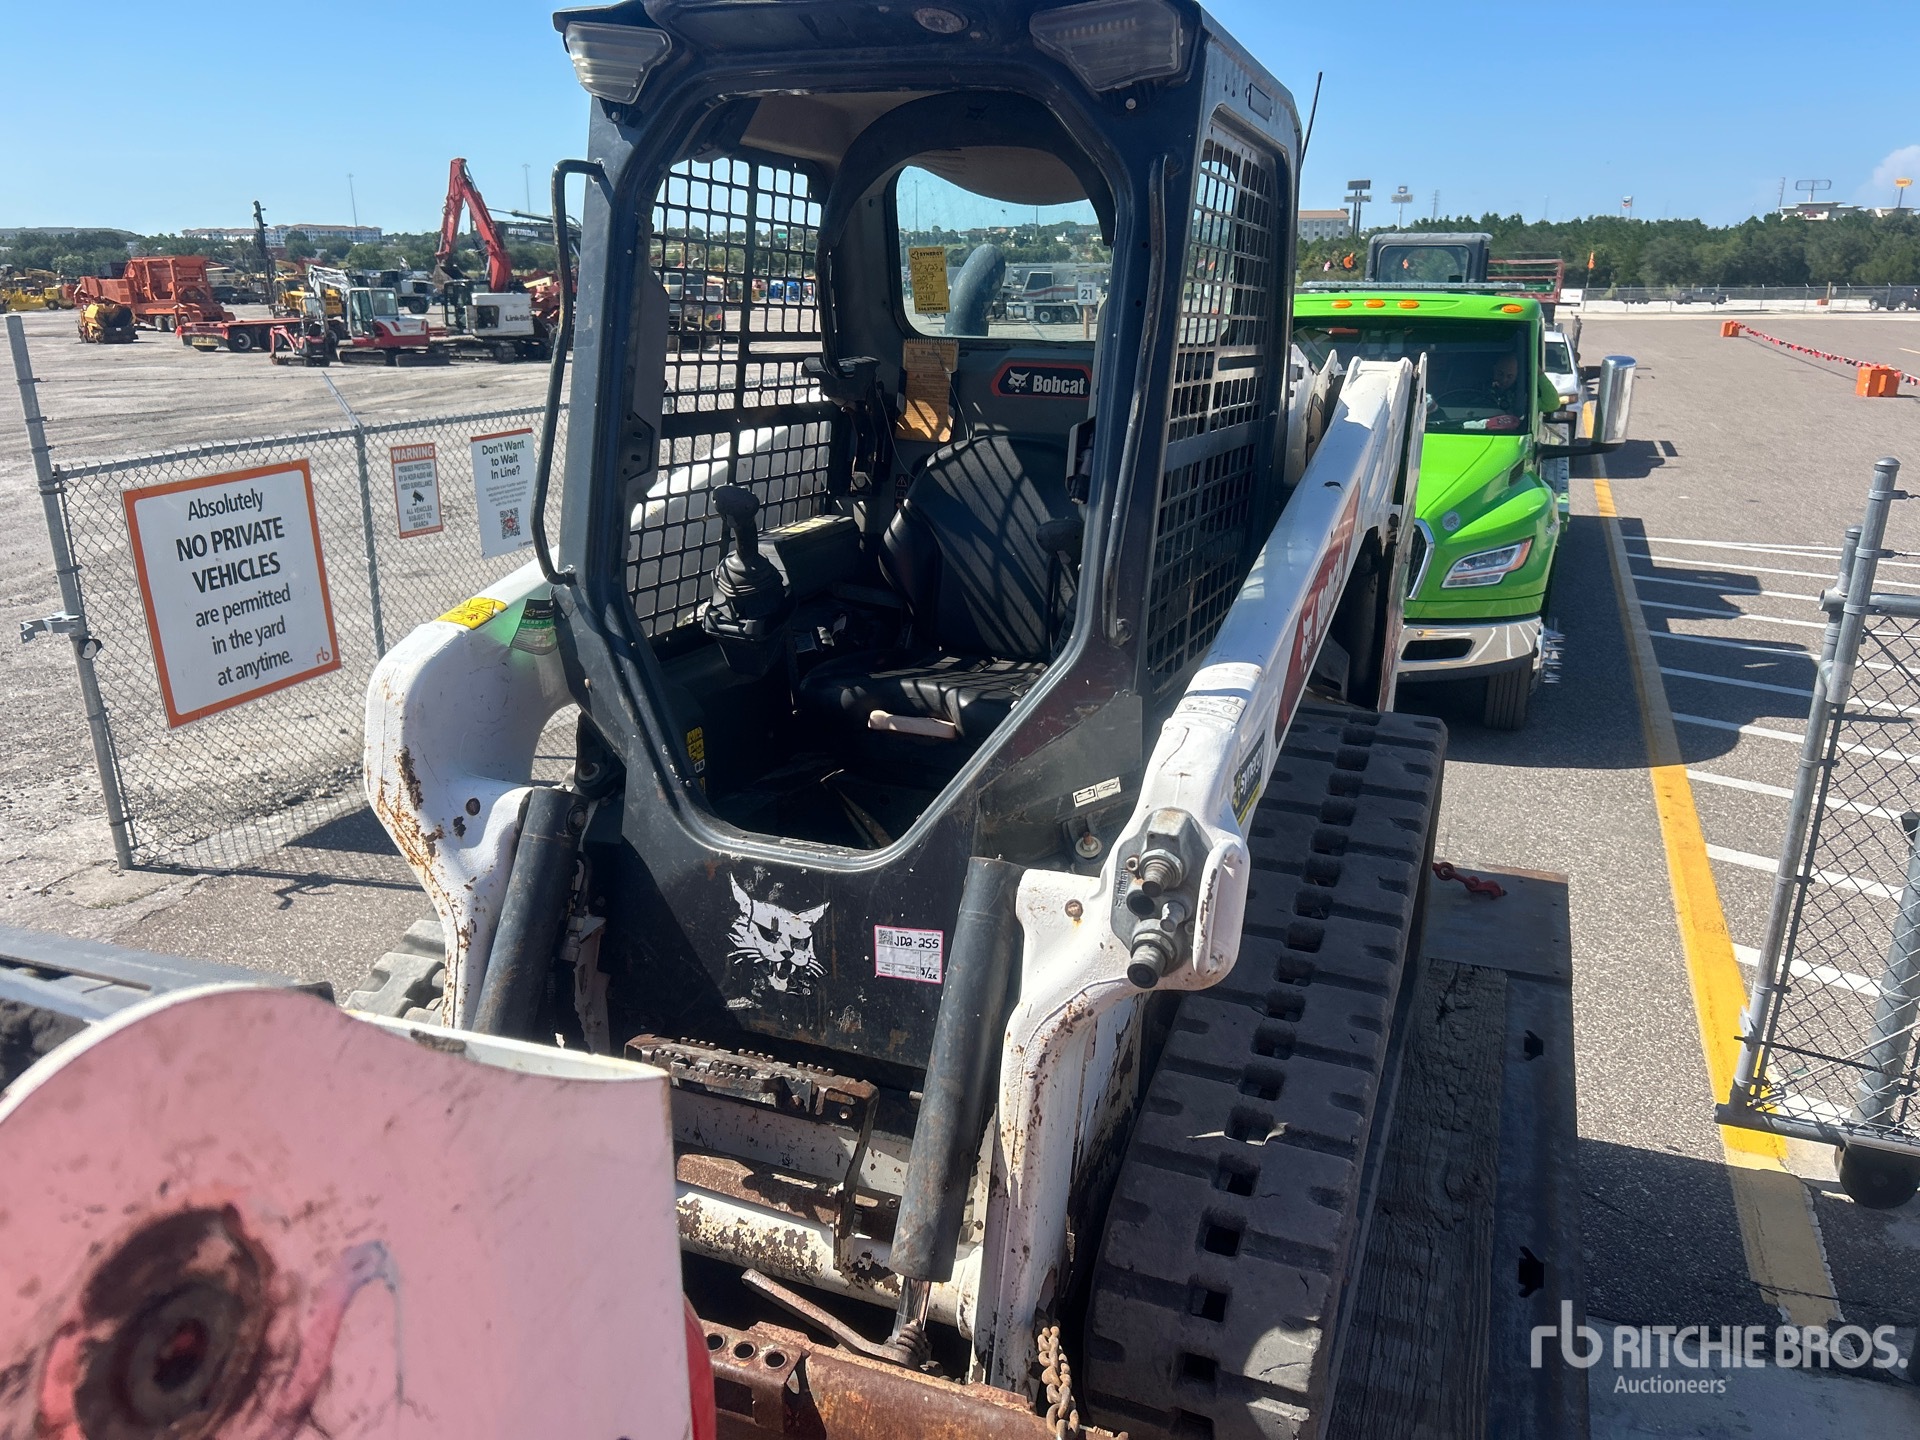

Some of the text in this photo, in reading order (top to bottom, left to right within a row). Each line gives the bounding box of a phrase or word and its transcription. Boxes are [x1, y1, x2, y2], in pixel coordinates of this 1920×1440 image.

[508, 227, 539, 237] HYUNDAI
[1081, 289, 1092, 300] 21
[1032, 375, 1085, 394] Bobcat
[393, 445, 434, 461] WARNING
[482, 440, 525, 455] Don't Want
[491, 452, 518, 467] to Wait
[491, 465, 521, 480] In Line?
[188, 488, 263, 520] Absolutely
[176, 517, 285, 561] NO PRIVATE
[192, 552, 281, 593] VEHICLES
[195, 583, 291, 627] are permitted
[212, 616, 287, 655] in the yard
[218, 650, 294, 686] at anytime.
